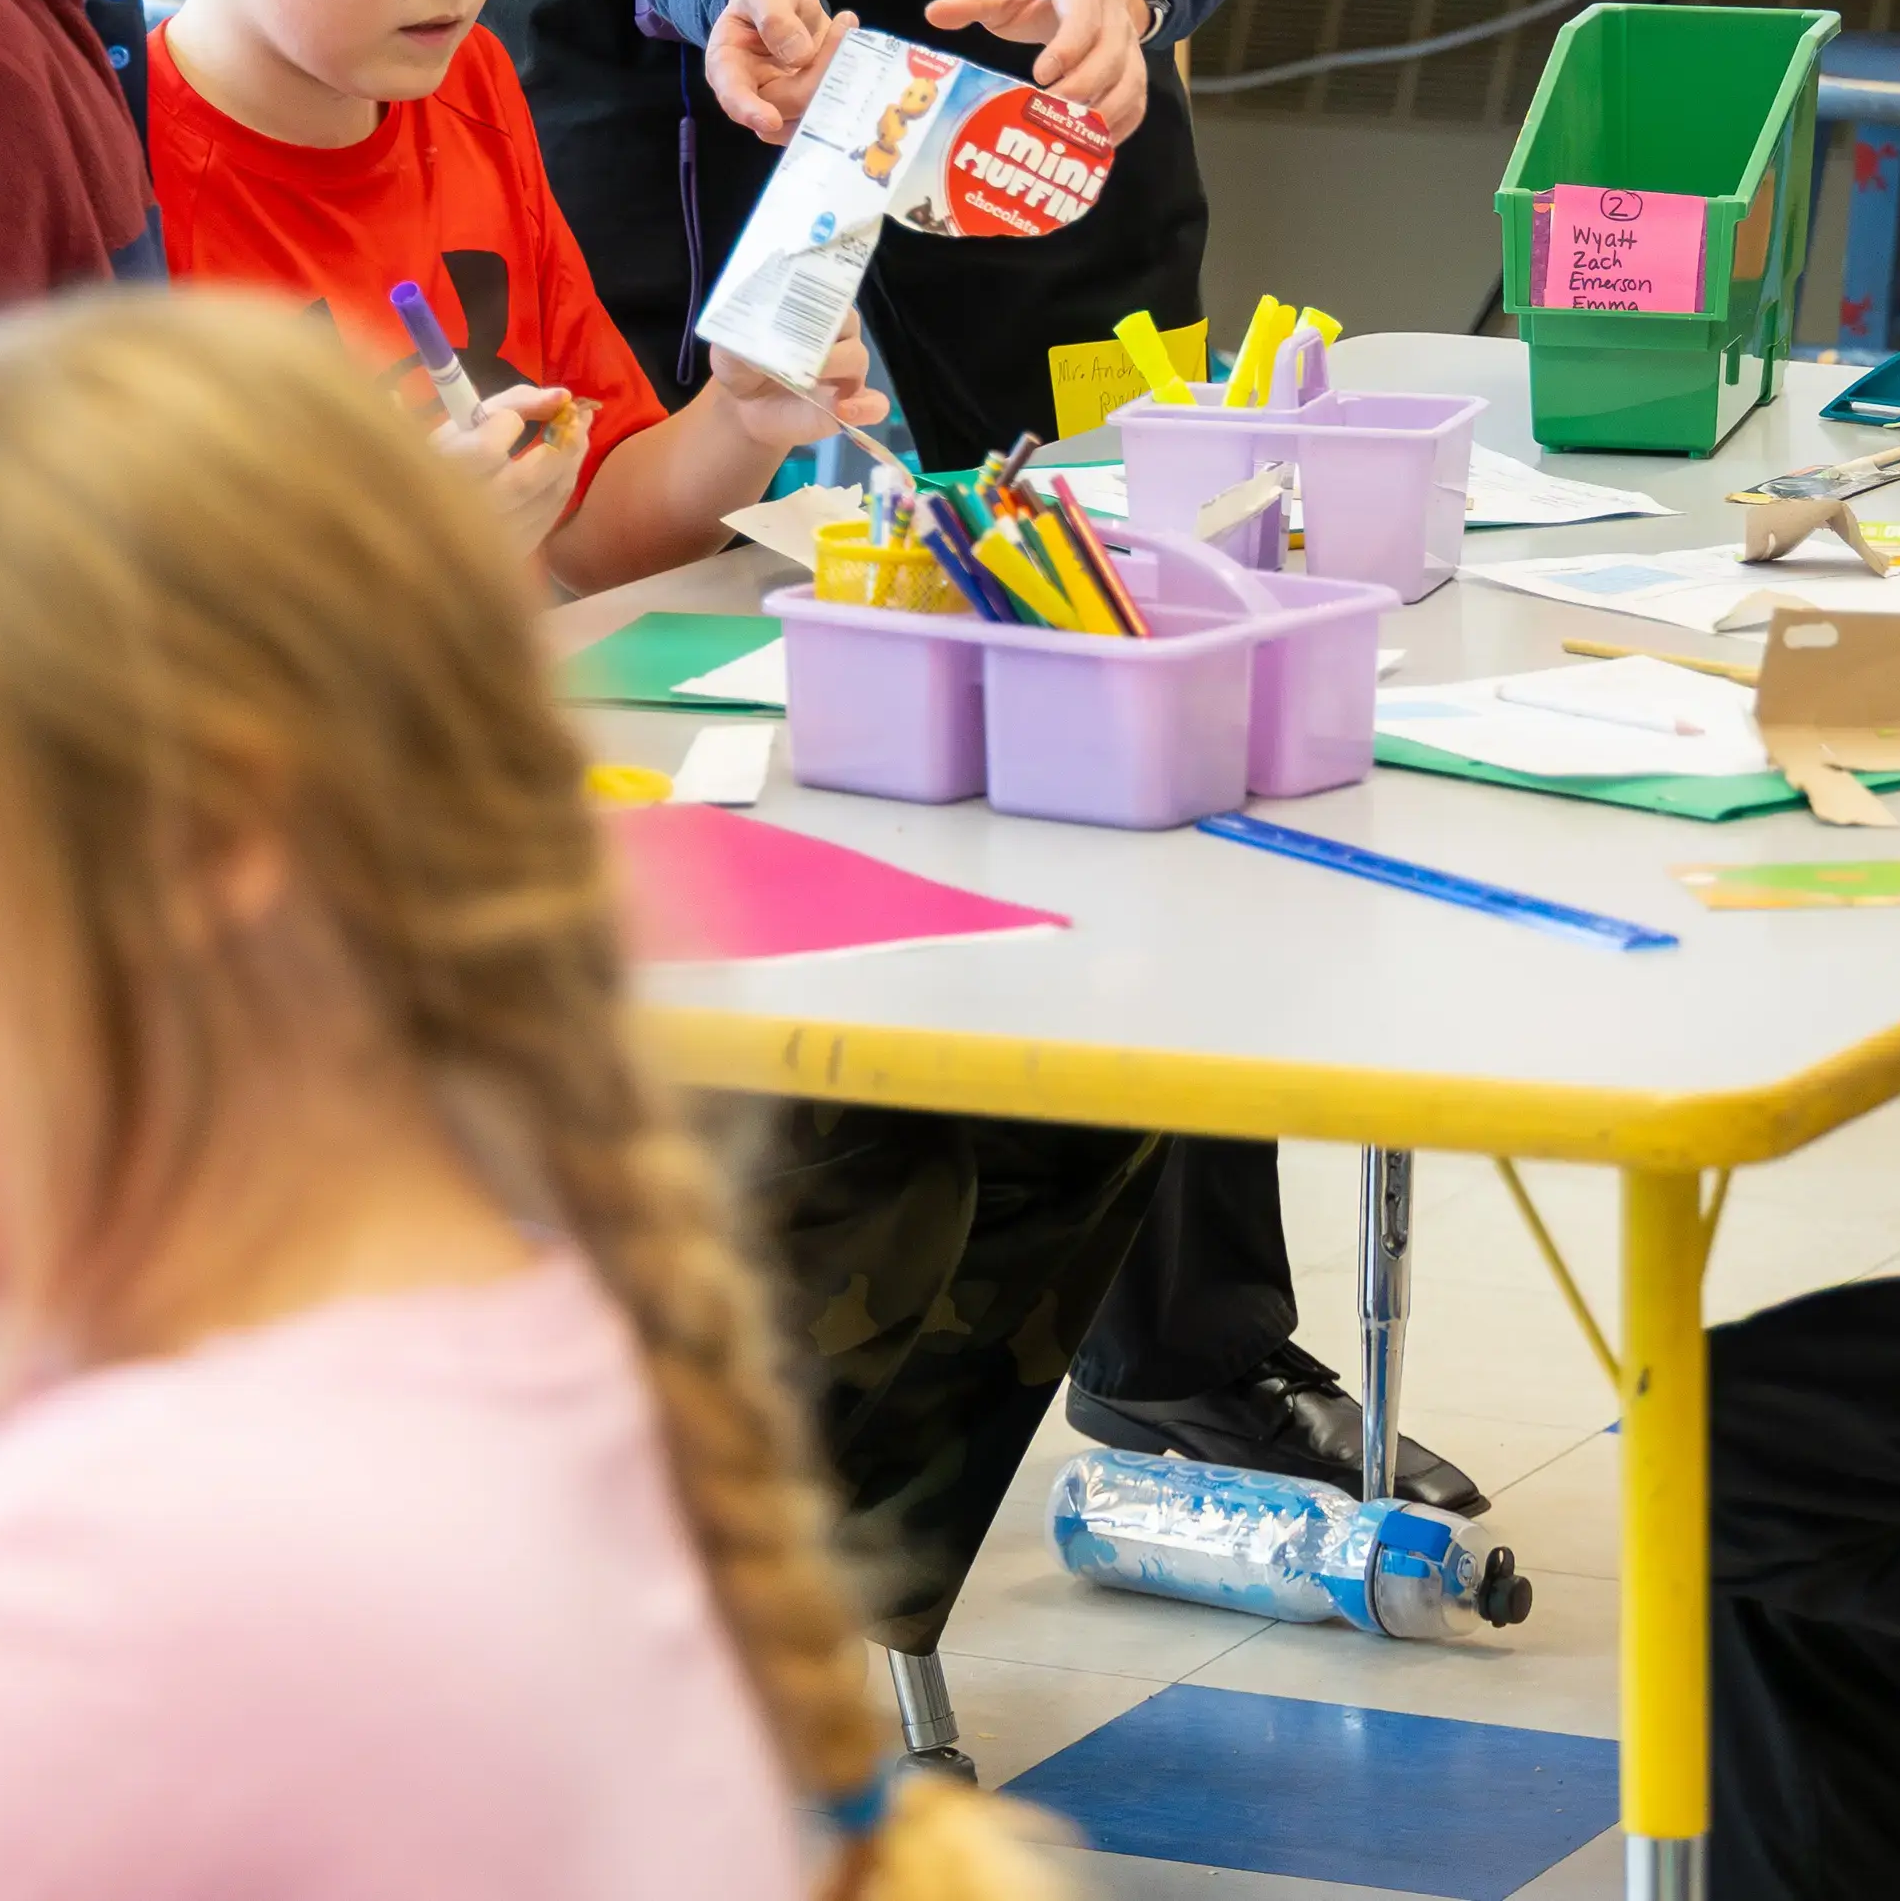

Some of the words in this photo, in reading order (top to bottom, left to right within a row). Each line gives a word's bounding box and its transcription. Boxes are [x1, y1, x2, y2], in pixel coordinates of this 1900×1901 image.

[1030, 98, 1073, 129] Baker's
[996, 126, 1106, 201] mini
[964, 190, 1041, 236] chocolate
[1608, 196, 1629, 218] 2
[1573, 225, 1638, 254] Wyatt
[1573, 250, 1623, 271] Zach
[1569, 271, 1653, 294] Emerson
[1572, 295, 1640, 312] Emma
[1057, 359, 1086, 385] Mr.
